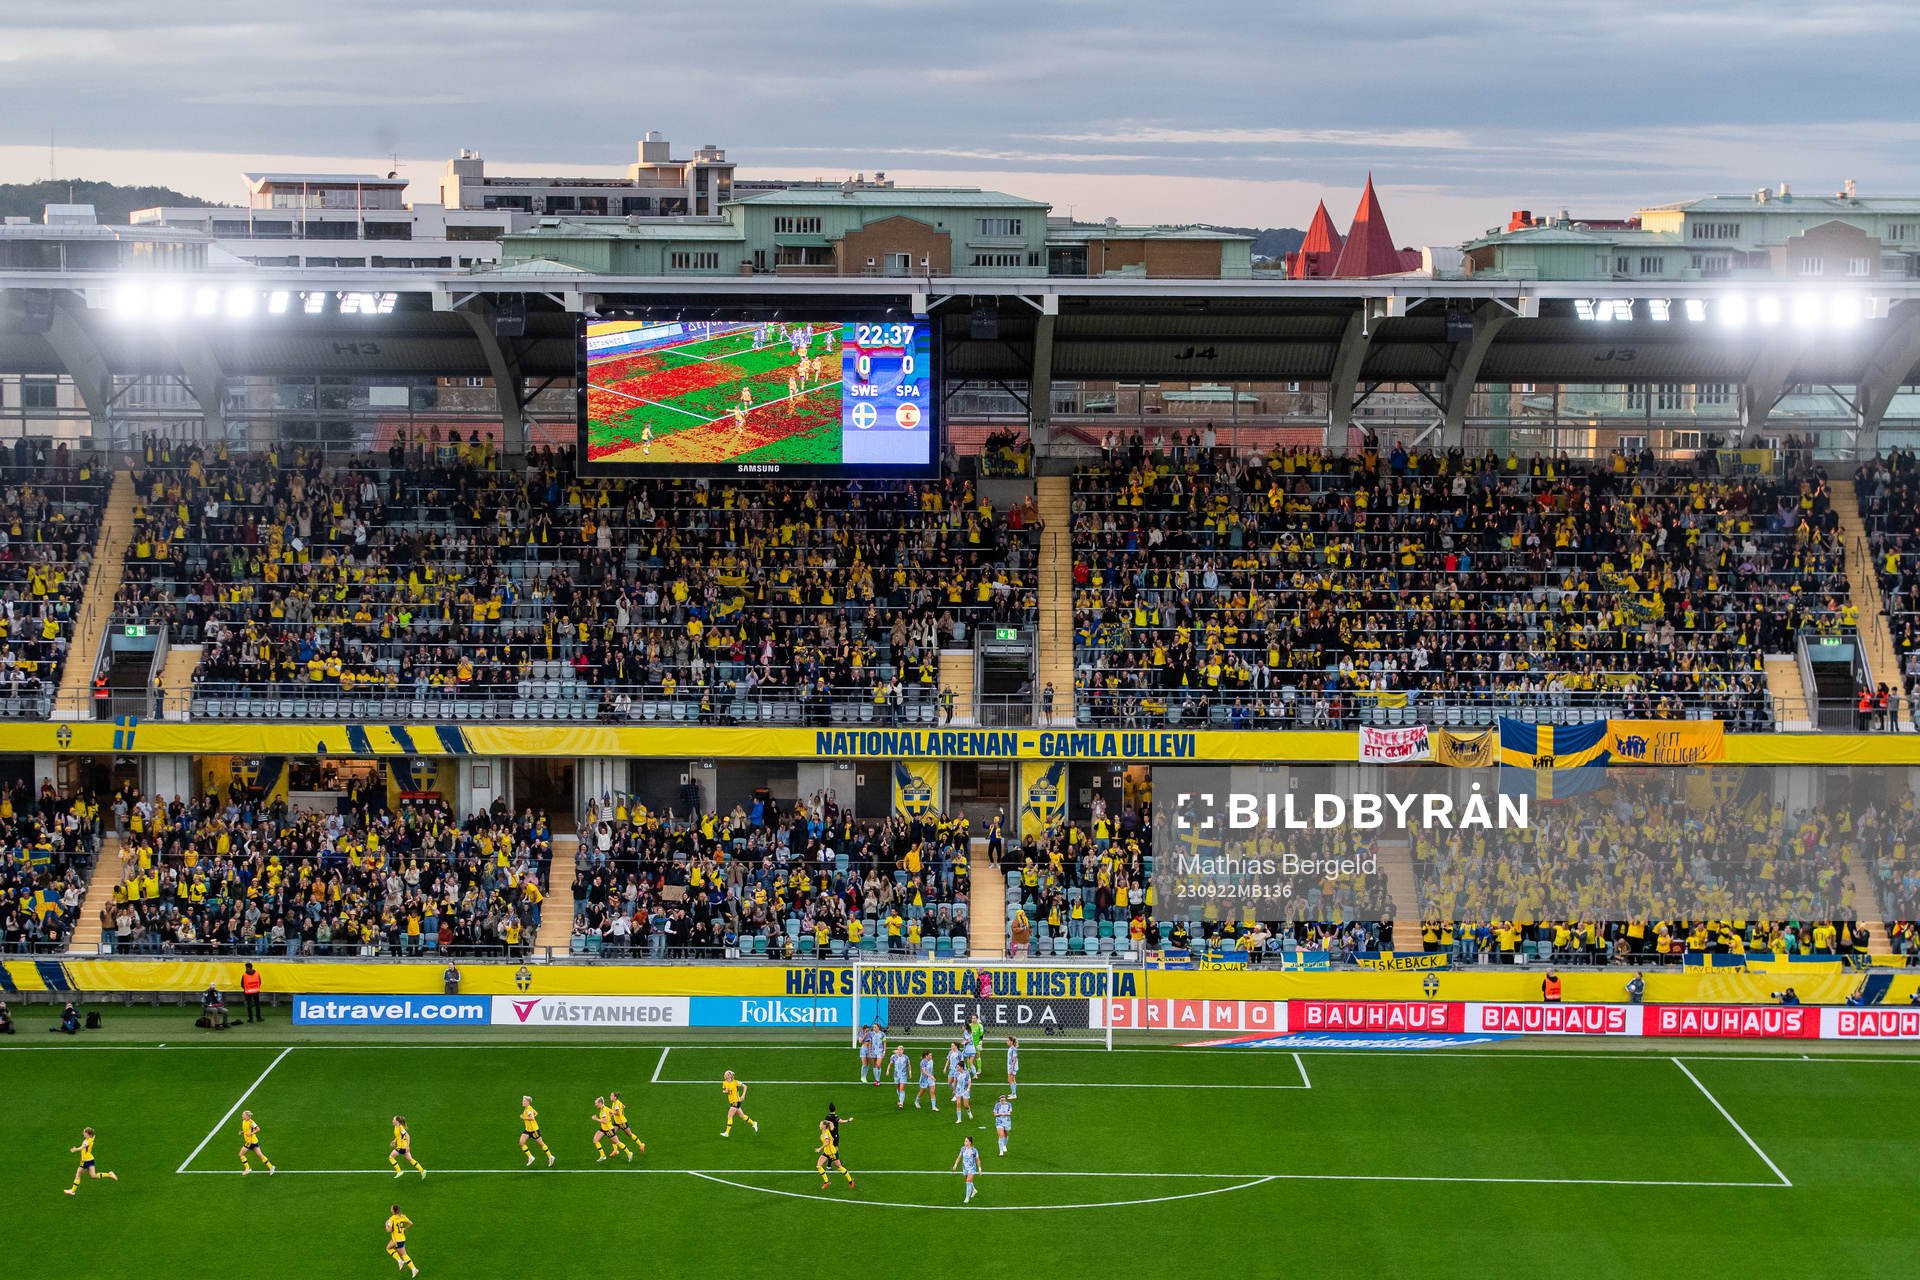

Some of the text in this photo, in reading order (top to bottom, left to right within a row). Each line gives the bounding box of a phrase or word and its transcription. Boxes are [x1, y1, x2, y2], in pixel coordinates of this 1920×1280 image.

[858, 325, 915, 345] 22:37
[859, 356, 914, 375] 0 0
[851, 385, 920, 397] SWE SPA
[738, 464, 780, 473] SAMSUNG
[816, 731, 1018, 757] NATIONALARENAN
[1039, 732, 1118, 758] GAMLA
[1121, 733, 1196, 758] ULLEVI
[1364, 728, 1399, 746] TACK
[1655, 731, 1681, 748] SOFT
[1364, 744, 1383, 758] ETT
[1415, 738, 1430, 753] VM
[786, 968, 1136, 997] HÄR SKRIVS BLÅUL HISTORIA
[300, 1001, 484, 1021] latravel.com
[542, 1001, 673, 1024] VÄSTANHEDE
[740, 1001, 838, 1024] Folksam
[1111, 1003, 1268, 1024] CRAMO
[1307, 1004, 1448, 1027] BAUHAUS
[1484, 1006, 1625, 1029] BAUHAUS
[1662, 1009, 1803, 1032] BAUHAUS
[1840, 1013, 1918, 1033] BAUH
